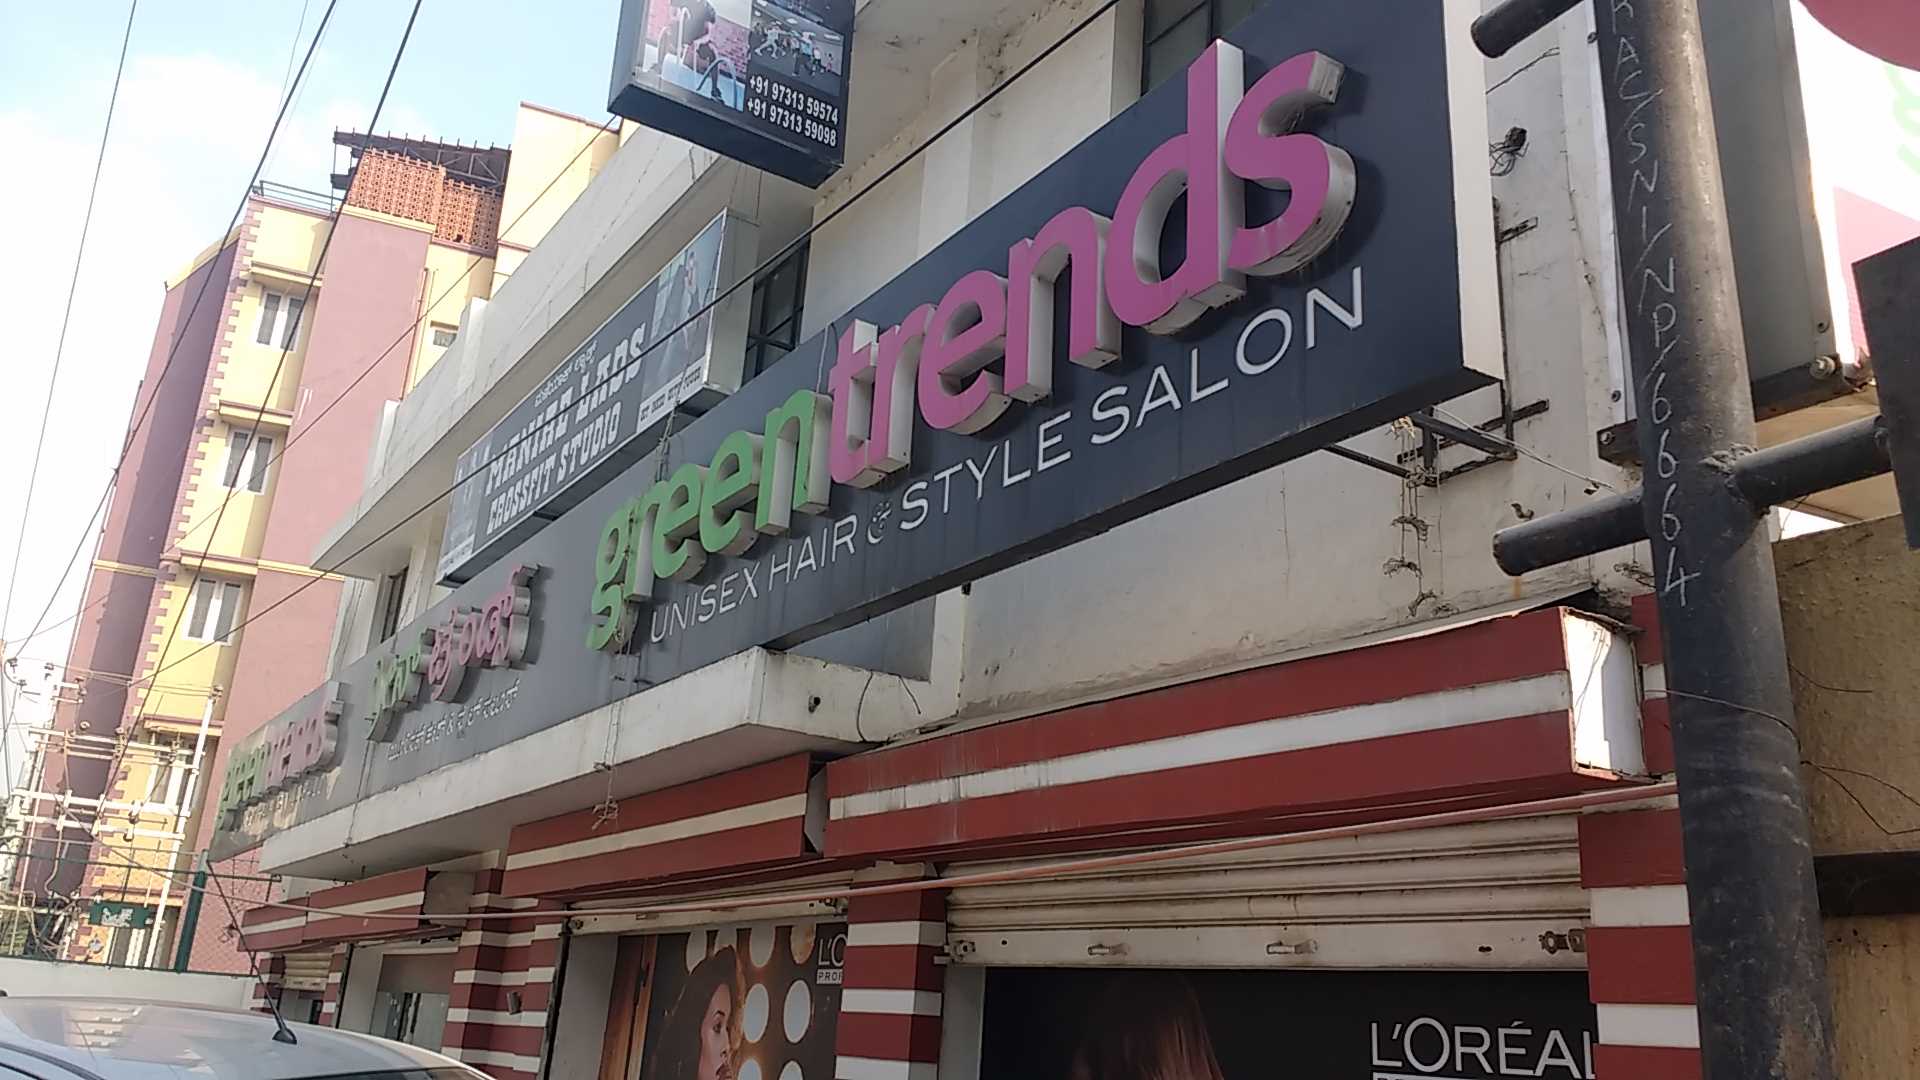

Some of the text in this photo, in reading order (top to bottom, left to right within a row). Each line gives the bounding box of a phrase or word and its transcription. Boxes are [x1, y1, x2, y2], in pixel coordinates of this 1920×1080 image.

[747, 98, 837, 147] +91 97313 59098
[750, 75, 838, 126] +91 97313 59574
[575, 322, 646, 424] LABS
[486, 402, 622, 536] CROSSFIT STUDIO
[651, 266, 1364, 644] UNISEX HAIR & STYLE SALON
